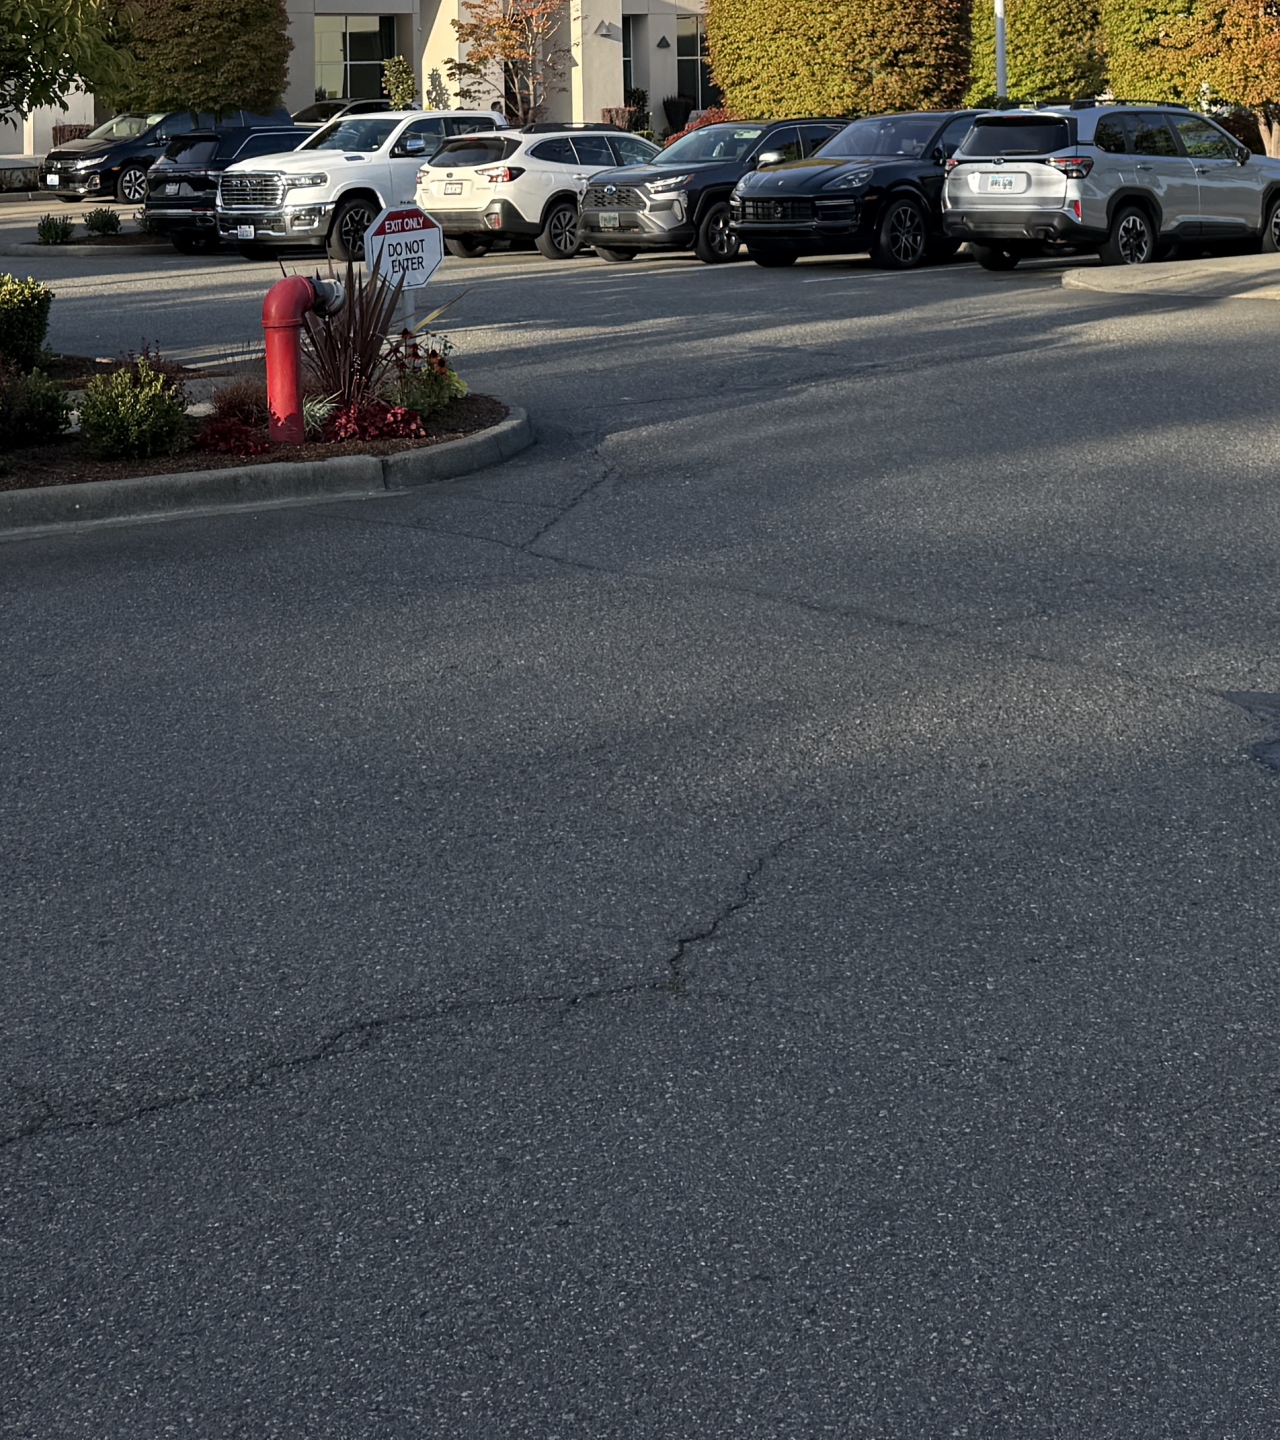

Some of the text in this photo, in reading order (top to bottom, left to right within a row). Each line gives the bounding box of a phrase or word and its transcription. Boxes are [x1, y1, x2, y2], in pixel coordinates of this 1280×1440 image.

[385, 216, 424, 233] EXIT ONLY
[388, 239, 425, 257] DO NOT
[391, 256, 425, 273] ENTER
